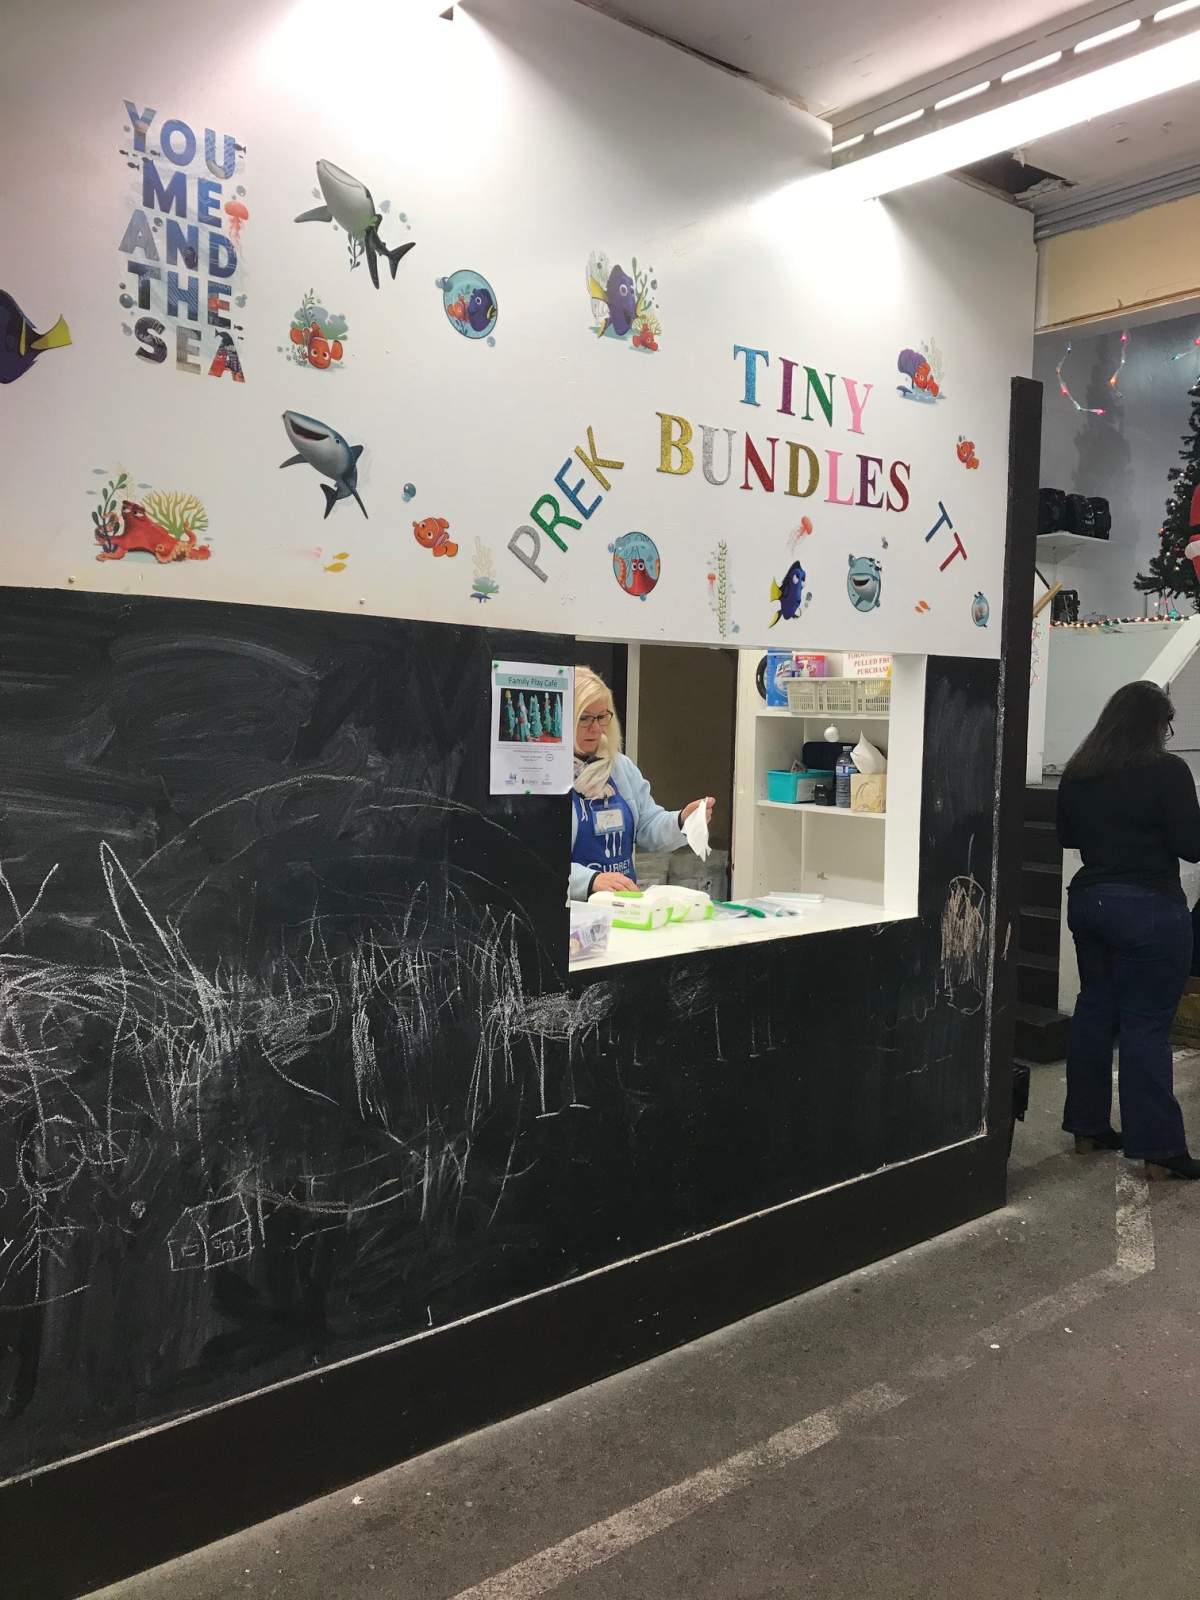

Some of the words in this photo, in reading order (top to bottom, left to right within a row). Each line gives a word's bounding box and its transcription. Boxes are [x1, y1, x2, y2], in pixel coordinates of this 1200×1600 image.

[123, 100, 236, 180] YOU
[142, 158, 222, 228] ME
[118, 209, 238, 279] AND
[127, 260, 232, 329] THE
[134, 316, 246, 384] SEA
[733, 344, 874, 435] TINY
[655, 411, 911, 512] BUNDLES
